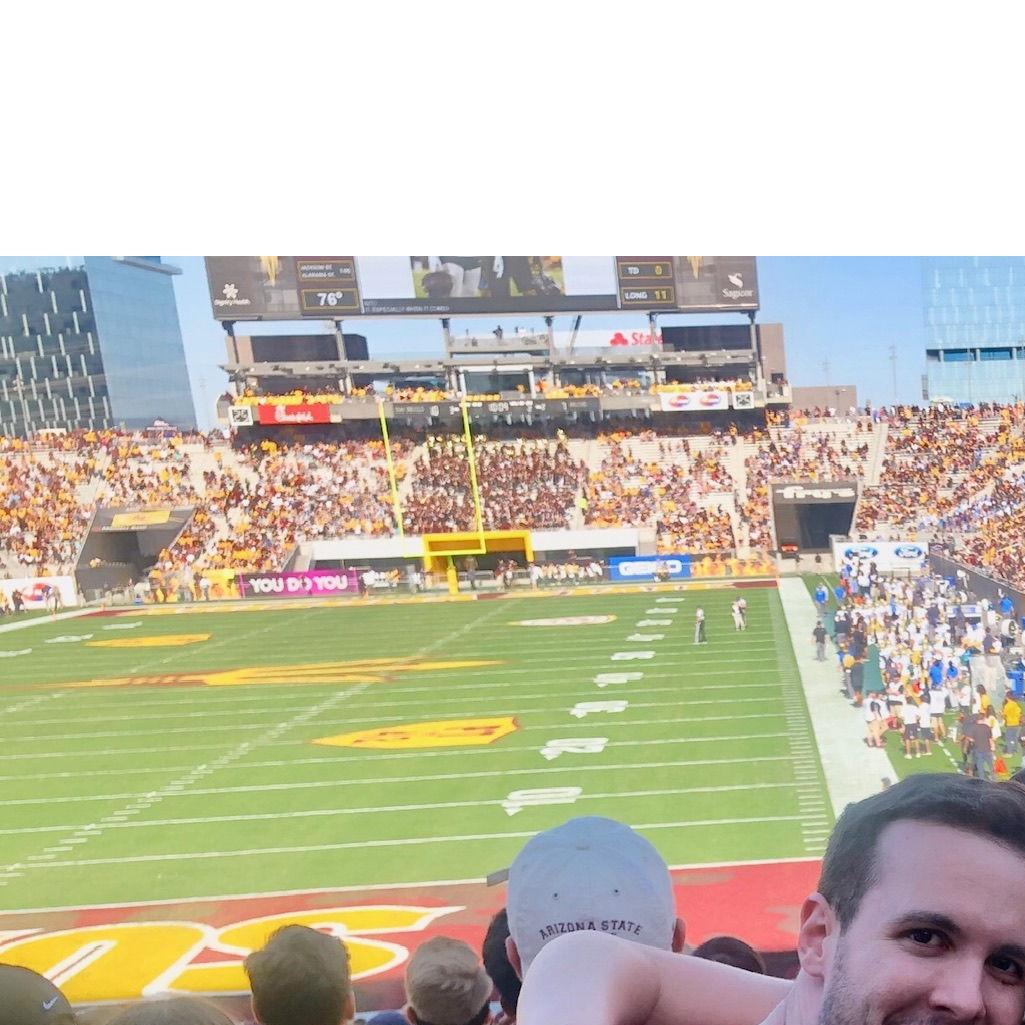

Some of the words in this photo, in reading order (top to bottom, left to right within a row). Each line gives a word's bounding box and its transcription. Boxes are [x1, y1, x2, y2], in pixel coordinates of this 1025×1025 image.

[249, 578, 284, 594] YOU
[313, 575, 348, 591] YOU
[539, 920, 596, 940] ARIZONA
[601, 919, 643, 936] STATE
